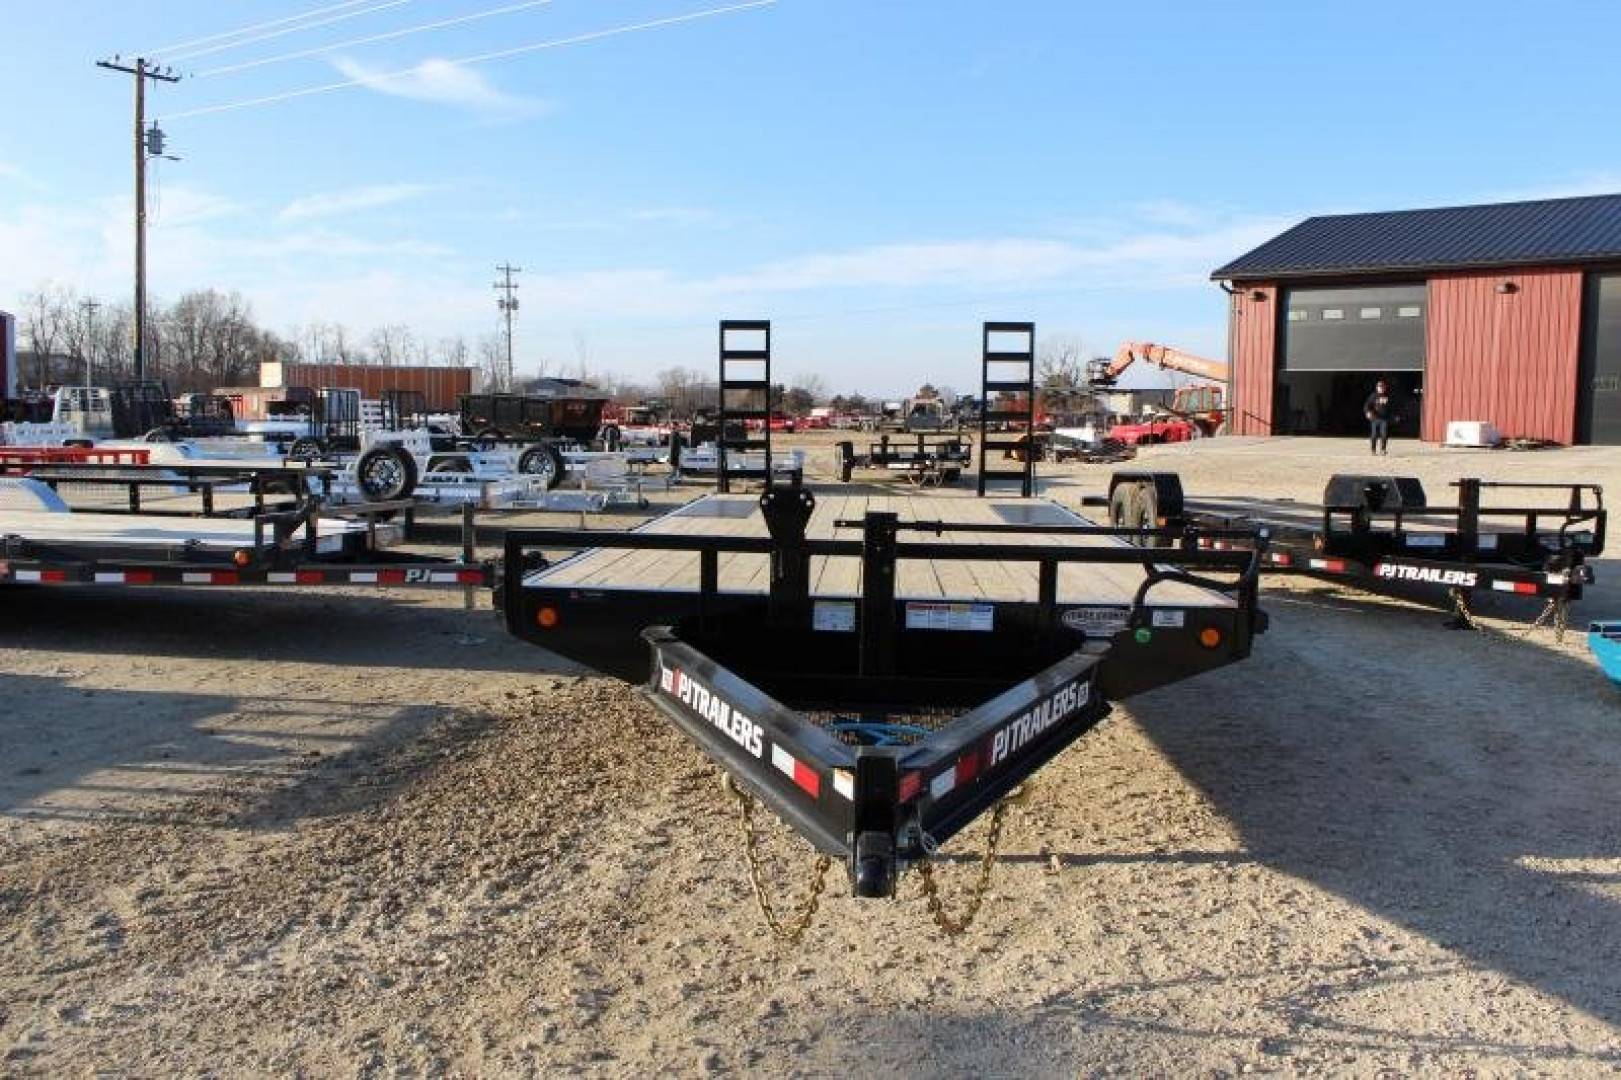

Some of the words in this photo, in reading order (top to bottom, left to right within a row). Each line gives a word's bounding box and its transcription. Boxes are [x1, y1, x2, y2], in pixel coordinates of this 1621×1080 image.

[405, 568, 431, 582] PJ
[1398, 564, 1478, 587] TRAILERS
[691, 680, 764, 759] TRAILERS
[1010, 682, 1078, 751] TRAILERS
